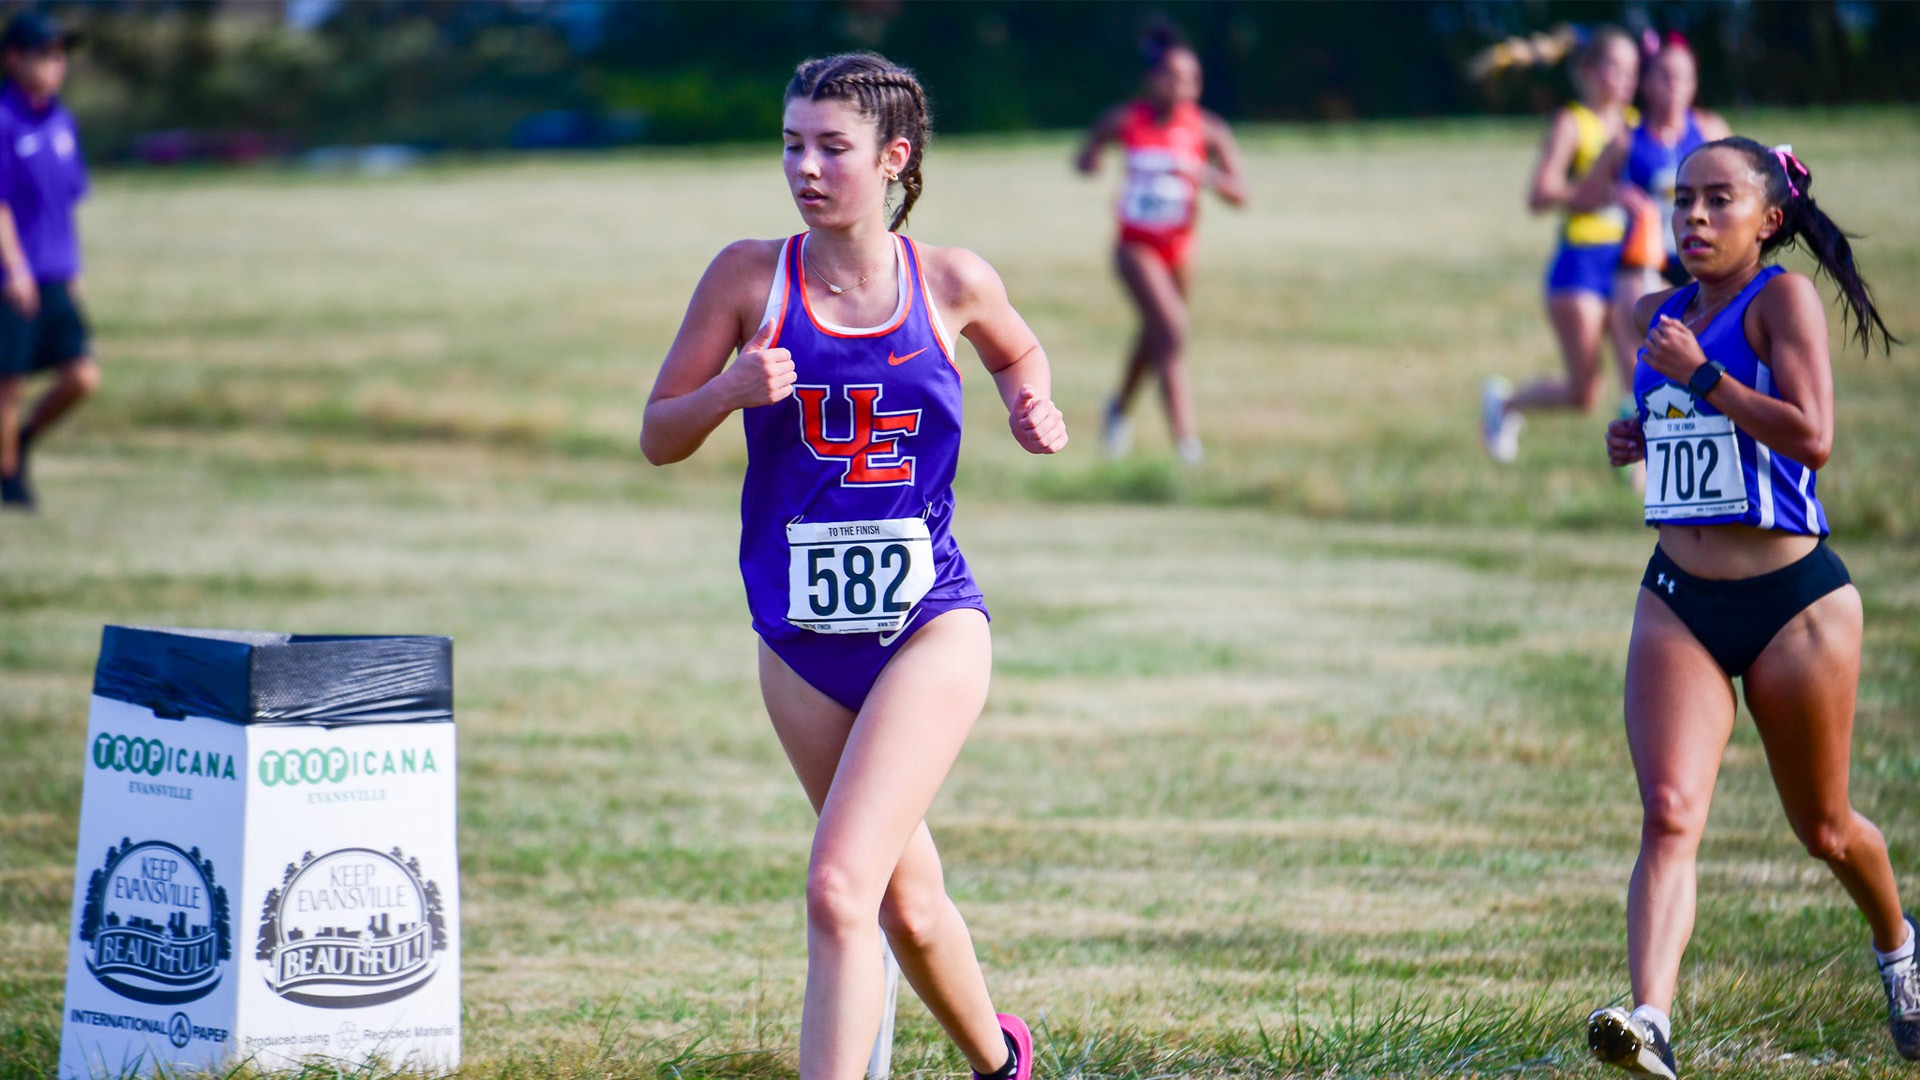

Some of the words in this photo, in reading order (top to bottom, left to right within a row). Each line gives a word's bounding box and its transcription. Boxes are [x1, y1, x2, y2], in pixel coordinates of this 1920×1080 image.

[793, 384, 922, 487] UE
[1656, 438, 1722, 502] 702
[828, 527, 839, 537] TO
[840, 526, 855, 536] THE
[856, 525, 880, 535] FINISH
[807, 543, 912, 617] 582
[93, 732, 236, 781] TROPICANA
[258, 747, 437, 787] TROPICANA
[129, 781, 193, 801] EVANSVILLE
[308, 789, 388, 804] EVANSVILLE
[142, 857, 179, 882] KEEP
[330, 864, 376, 887] KEEP
[115, 876, 201, 910] EVANSVILLE
[298, 885, 408, 912] EVANSVILLE
[71, 1009, 168, 1035] INTERNATIONAL
[193, 1026, 228, 1043] PAPER
[301, 1033, 330, 1045] using
